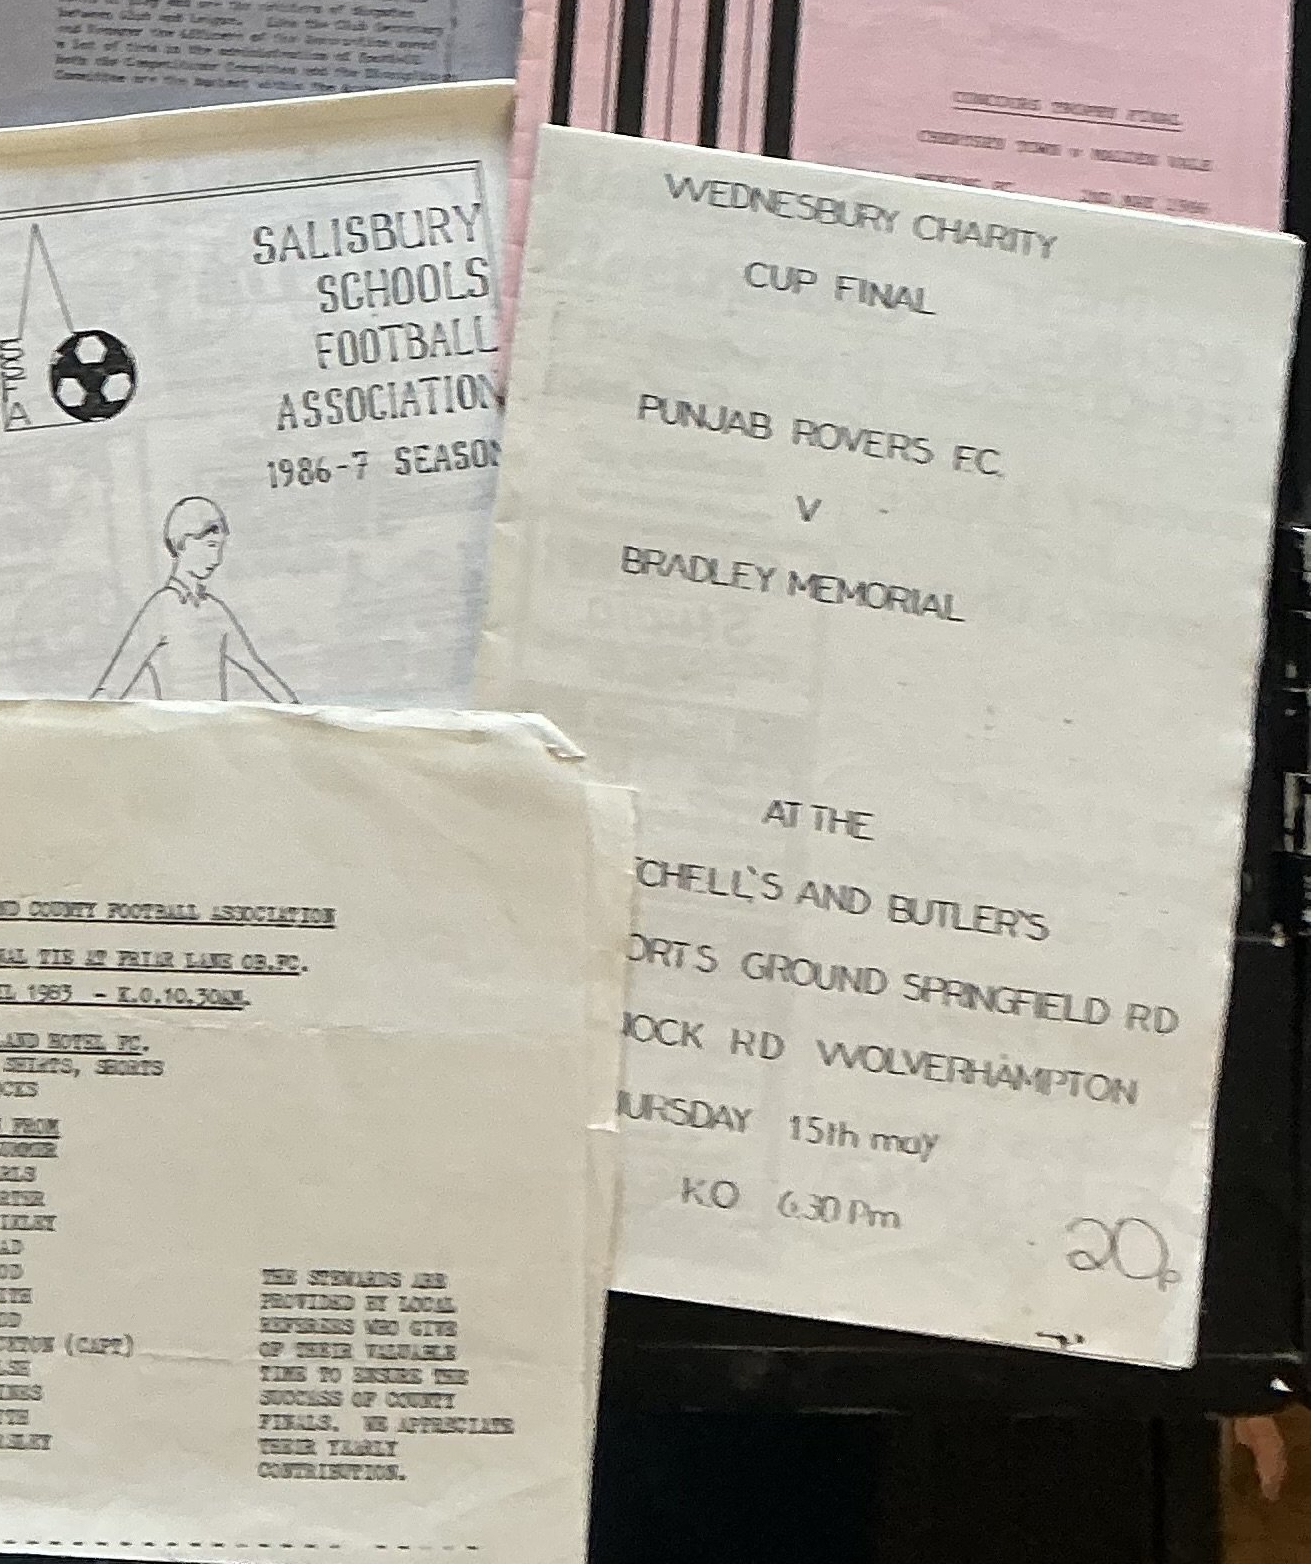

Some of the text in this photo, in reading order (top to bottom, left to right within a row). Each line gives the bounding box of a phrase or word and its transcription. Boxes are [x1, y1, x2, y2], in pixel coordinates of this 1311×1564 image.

[252, 203, 483, 266] SALISBURY
[664, 173, 900, 233] WEDNESBURY
[912, 214, 1058, 259] CHARITY
[316, 256, 491, 314] SCHOOLS
[743, 261, 937, 316] CUP FINAL
[315, 313, 500, 371] FOOTBALL
[638, 393, 773, 440] PUNJAB
[792, 418, 935, 465] ROVERS
[266, 450, 371, 490] 1986-7
[621, 545, 966, 623] BRADLEY MEMORIAL
[761, 799, 875, 841] AT THE
[29, 903, 98, 919] COUNTY
[107, 903, 200, 921] FOOTBALL
[209, 905, 336, 924] ASSOCIATION
[795, 880, 1051, 942] AND BUTLER'S
[741, 951, 1180, 1035] GROUND SPRINGFIELD RD
[730, 1028, 1138, 1105] RD WOLVERHAMPTON
[789, 1115, 860, 1149] 15th
[1064, 1216, 1182, 1293] 20p
